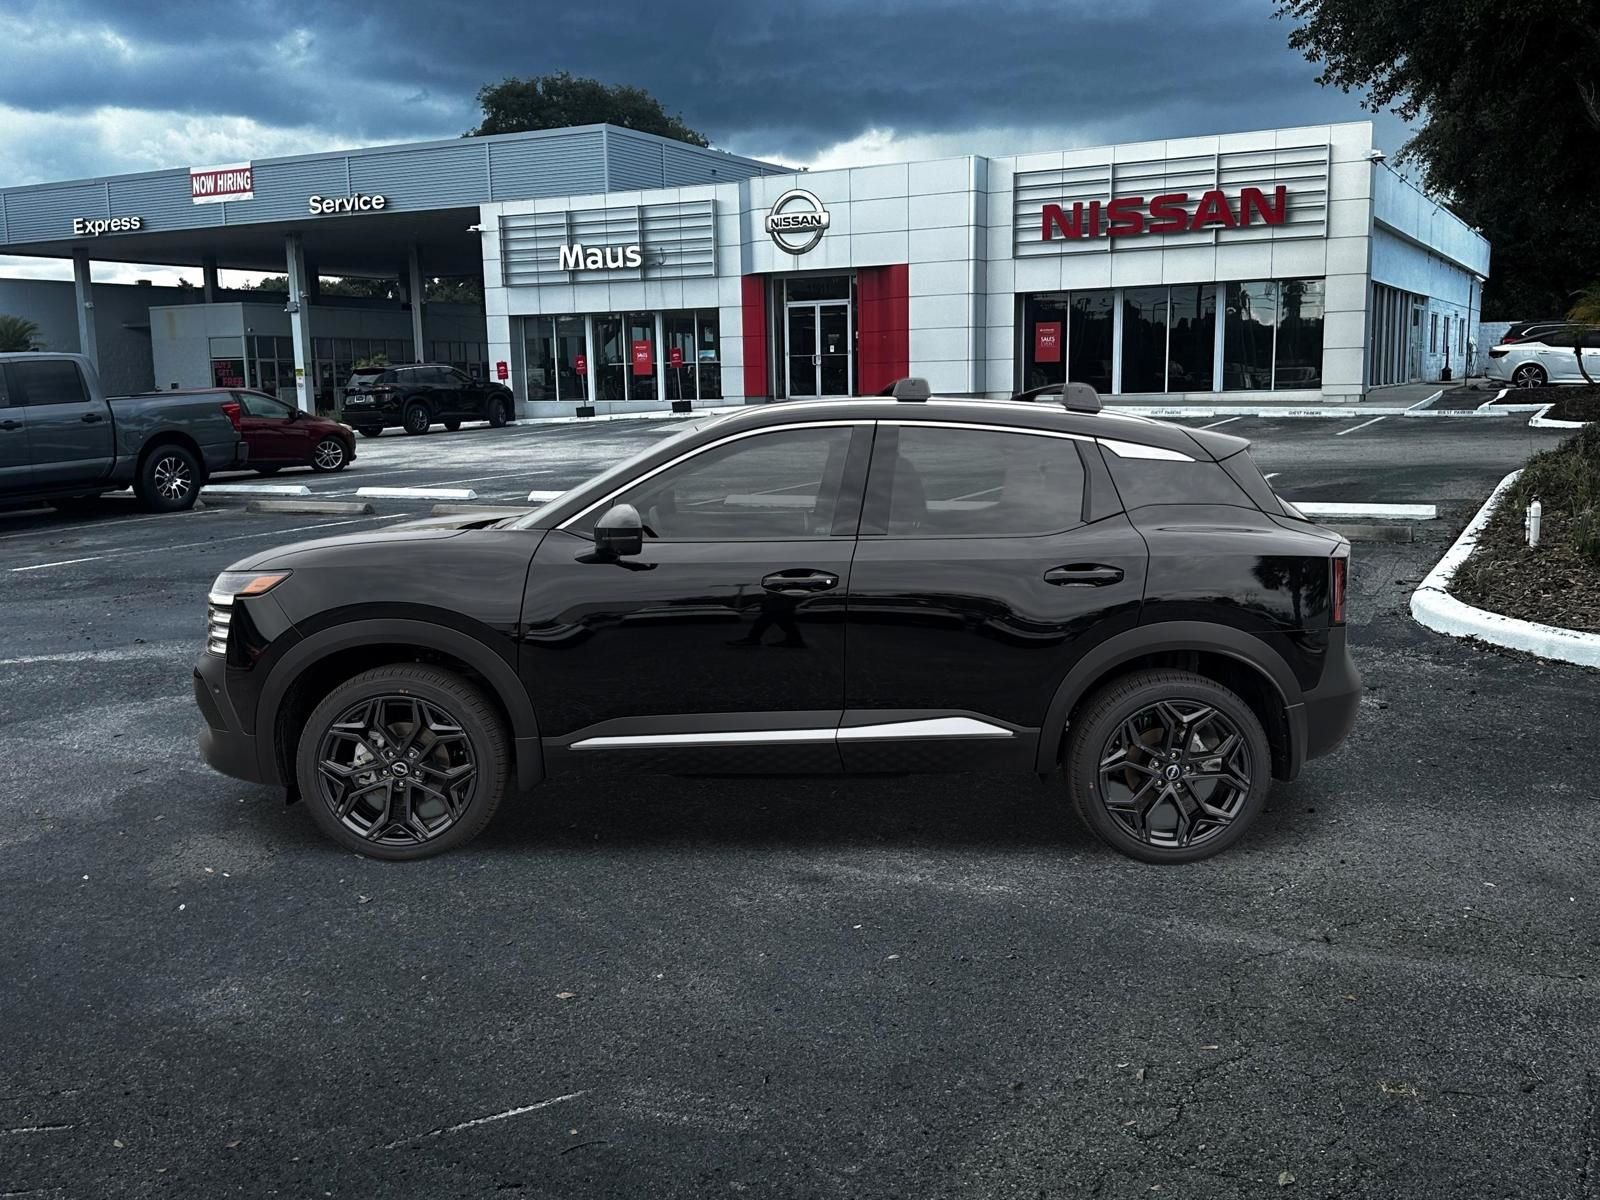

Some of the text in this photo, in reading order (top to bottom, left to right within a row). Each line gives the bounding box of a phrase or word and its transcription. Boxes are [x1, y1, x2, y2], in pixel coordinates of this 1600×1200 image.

[192, 171, 251, 195] NOW HIRING
[308, 192, 386, 215] Service
[1042, 185, 1287, 240] NISSAN
[73, 216, 141, 237] Express
[770, 215, 822, 228] NISSAN
[559, 243, 642, 271] Maus
